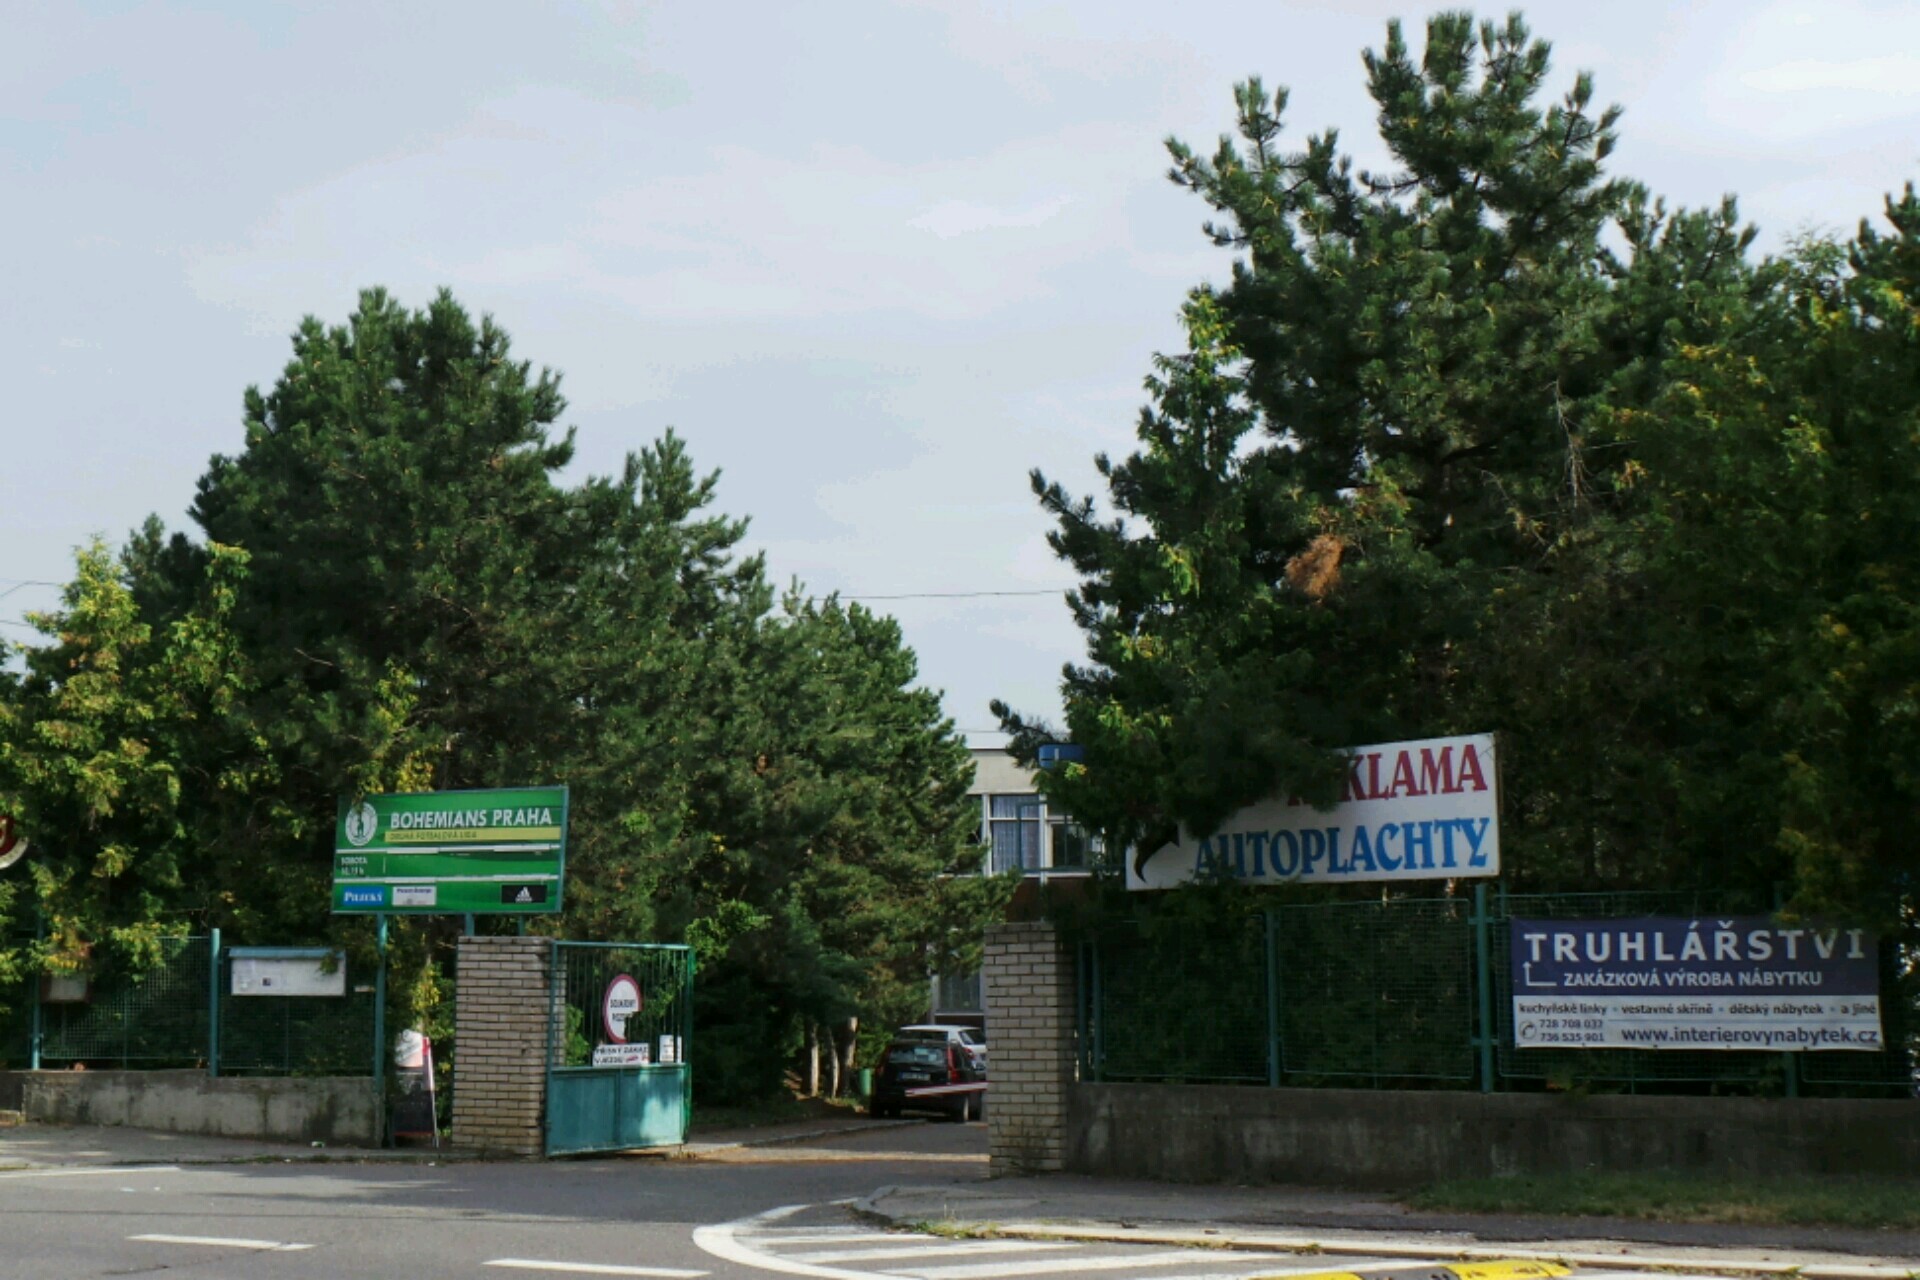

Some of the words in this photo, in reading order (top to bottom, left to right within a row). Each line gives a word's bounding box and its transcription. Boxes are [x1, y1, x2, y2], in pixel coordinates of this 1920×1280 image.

[390, 810, 487, 829] BOHEMIANS
[493, 808, 552, 827] PRAHA
[1194, 817, 1490, 879] AUTOPLACHTY
[1564, 969, 1659, 987] ZAKÁZKOVÁ
[1664, 969, 1734, 987] VÝROBA
[1739, 968, 1822, 987] NÁBYTKU
[1518, 1003, 1577, 1016] kuchyňské
[1580, 1003, 1607, 1016] linky
[1621, 1003, 1674, 1014] vestavné
[1677, 1003, 1714, 1014] skříně
[1730, 1003, 1769, 1016] dětský
[1773, 1003, 1824, 1016] nábytek
[1841, 1005, 1849, 1014] a
[1852, 1003, 1876, 1016] jiné
[1621, 1027, 1878, 1046] www.interierovynabytek.cz
